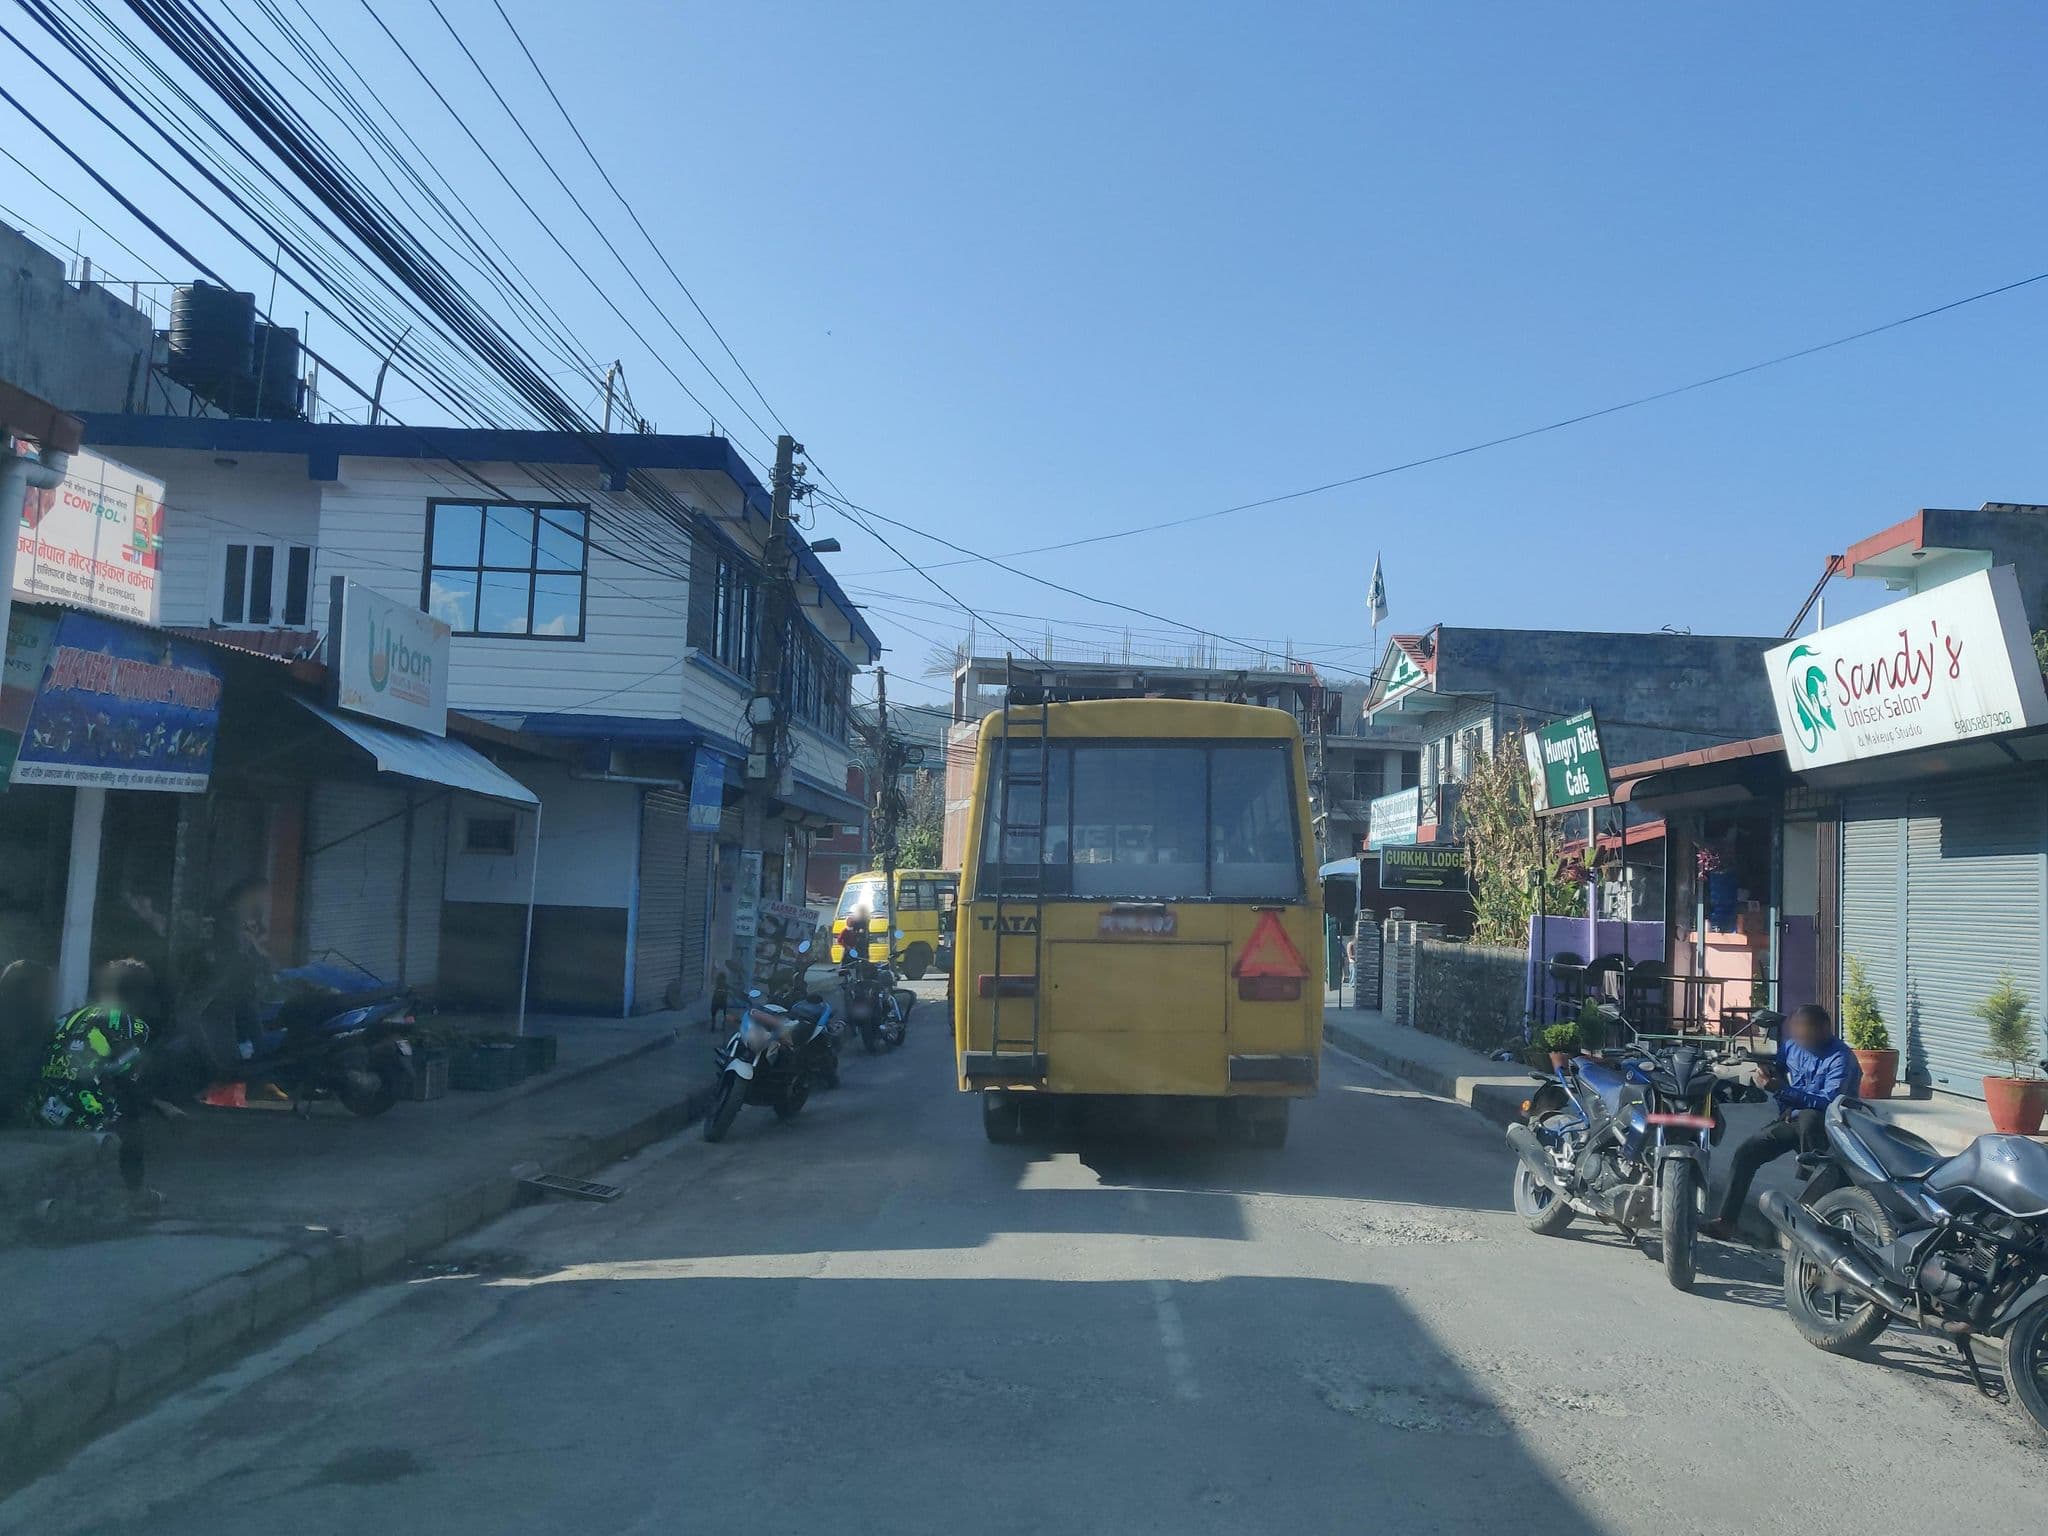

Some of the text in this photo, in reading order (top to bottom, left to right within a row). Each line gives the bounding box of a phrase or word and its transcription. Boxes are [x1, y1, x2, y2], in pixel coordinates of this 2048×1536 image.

[63, 491, 121, 523] CONTROL
[37, 538, 66, 565] नेपाल
[368, 611, 433, 693] Urban
[1834, 619, 1963, 707] Sandy's
[1844, 694, 1922, 728] Unisex Salon
[1544, 724, 1600, 766] Hungry Bite
[1865, 730, 1895, 746] Makeup
[1895, 723, 1923, 739] Studio
[1565, 766, 1590, 796] Café
[1385, 849, 1466, 868] GURKHA LODGE
[977, 915, 1041, 931] TATA
